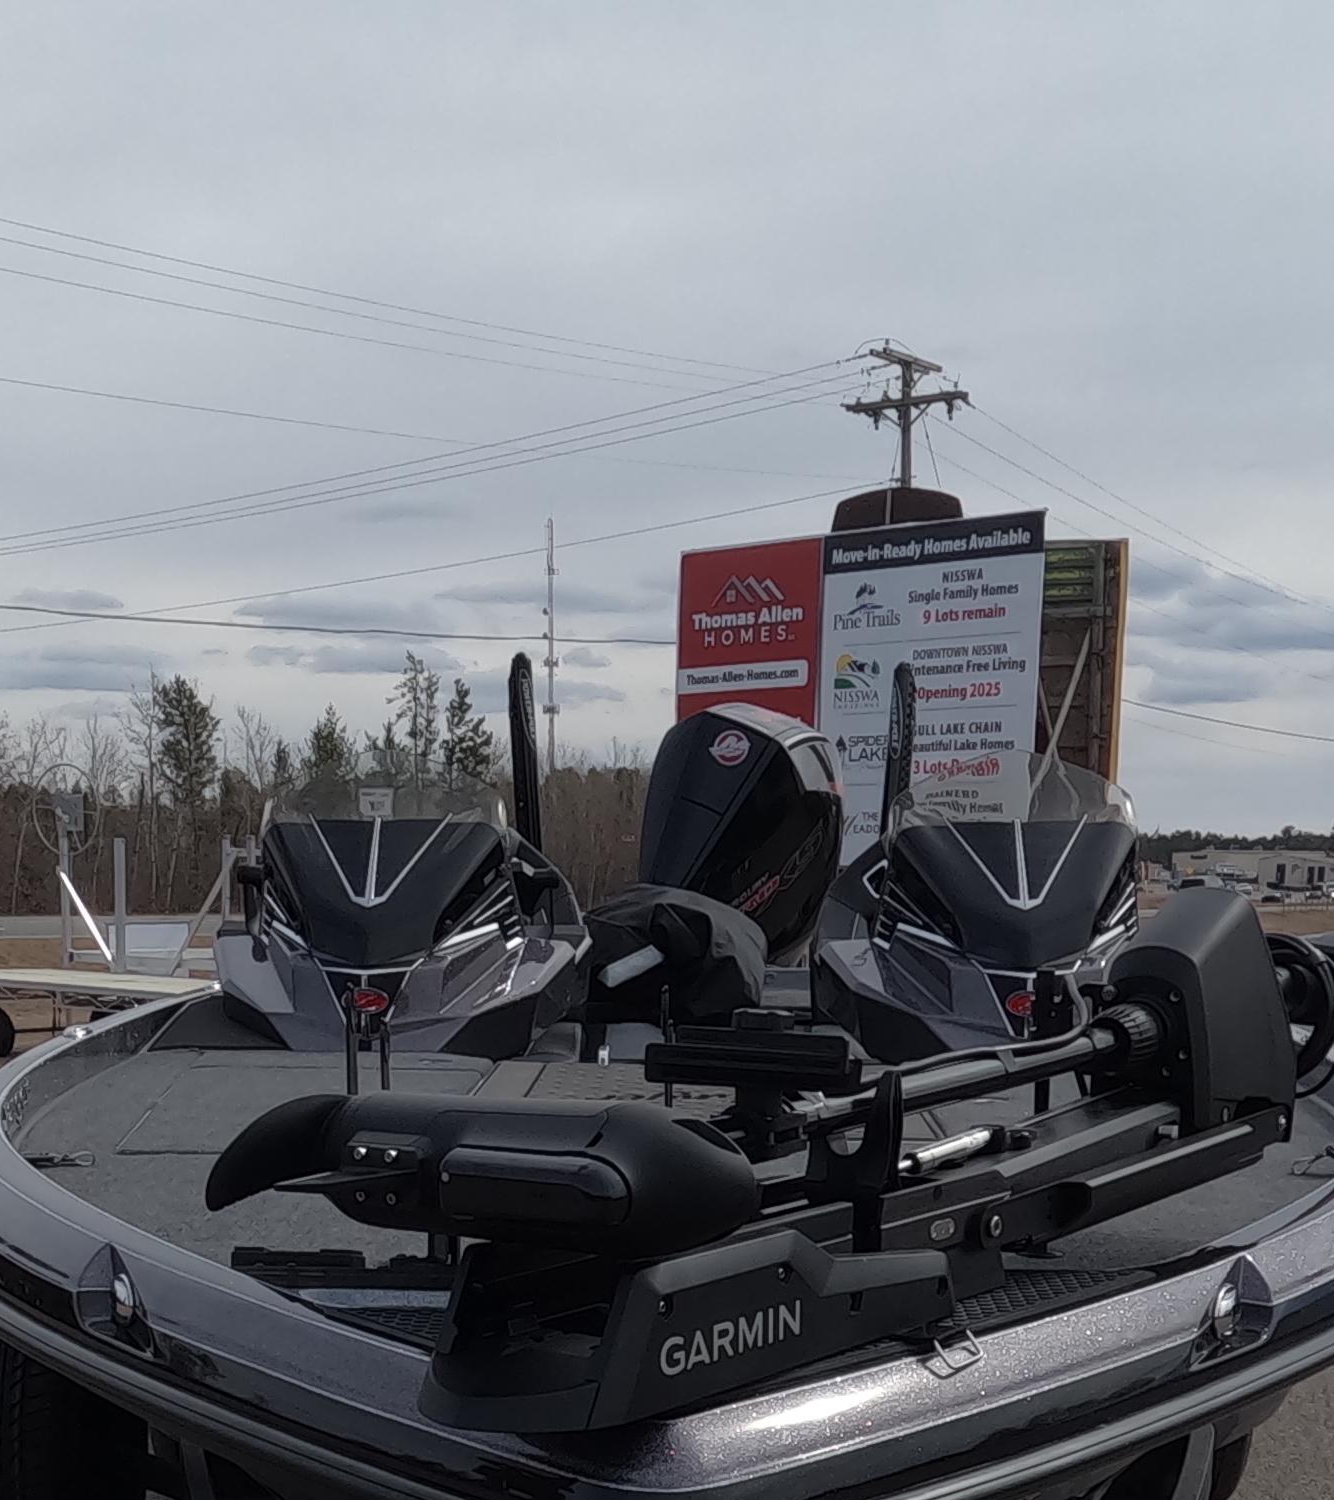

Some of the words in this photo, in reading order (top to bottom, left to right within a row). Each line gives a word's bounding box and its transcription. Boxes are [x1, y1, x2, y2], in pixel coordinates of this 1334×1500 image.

[832, 540, 922, 564] Move-In-Ready
[924, 538, 967, 555] Homes
[968, 527, 1031, 549] Available
[942, 568, 984, 583] NISSWA
[908, 589, 941, 605] Single
[943, 585, 979, 601] Family
[981, 583, 1019, 597] Homes
[692, 611, 756, 630] Thomas
[757, 605, 803, 624] Allen
[833, 613, 862, 631] Pine
[865, 610, 901, 627] Trails
[923, 610, 931, 624] 9
[935, 608, 959, 623] Lots
[962, 603, 1006, 620] remain
[704, 625, 787, 647] HOMES
[913, 646, 968, 661] DOWNTOWN
[971, 643, 1008, 656] NISSWA
[966, 660, 989, 673] Free
[992, 657, 1026, 673] Living
[686, 669, 799, 686] Thomas-Allen-Homes.com
[833, 690, 879, 703] NISSWA
[917, 684, 967, 703] Opening
[970, 682, 1001, 698] 2025
[940, 722, 966, 735] LAKE
[969, 721, 1002, 734] CHAIN
[912, 740, 952, 753] eautiful
[954, 740, 977, 751] Lake
[980, 738, 1015, 751] Homes
[913, 762, 920, 774] 3
[660, 1299, 801, 1376] GARMIN
